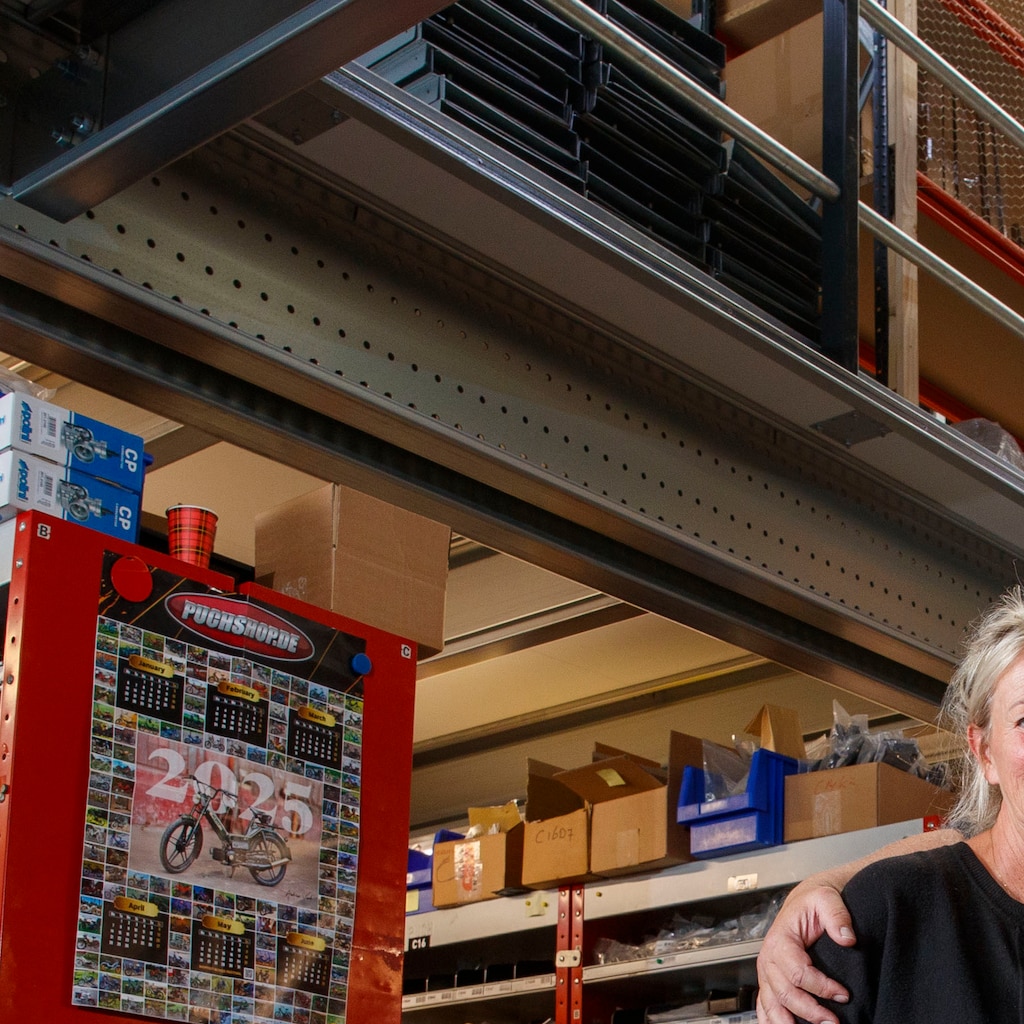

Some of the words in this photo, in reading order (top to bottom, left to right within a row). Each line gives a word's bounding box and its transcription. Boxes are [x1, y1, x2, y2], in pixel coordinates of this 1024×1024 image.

[20, 407, 32, 442] polini
[124, 447, 138, 473] CP
[18, 465, 30, 502] polini
[119, 505, 132, 530] CP
[39, 525, 49, 537] B
[182, 602, 300, 653] PUCHSHOP.DE
[402, 646, 410, 657] C
[138, 660, 166, 674] January
[226, 684, 255, 698] February
[308, 711, 326, 721] March
[146, 748, 313, 835] 2025
[128, 902, 145, 912] April
[217, 920, 232, 930] May
[300, 937, 315, 946] June
[411, 938, 427, 950] C16
